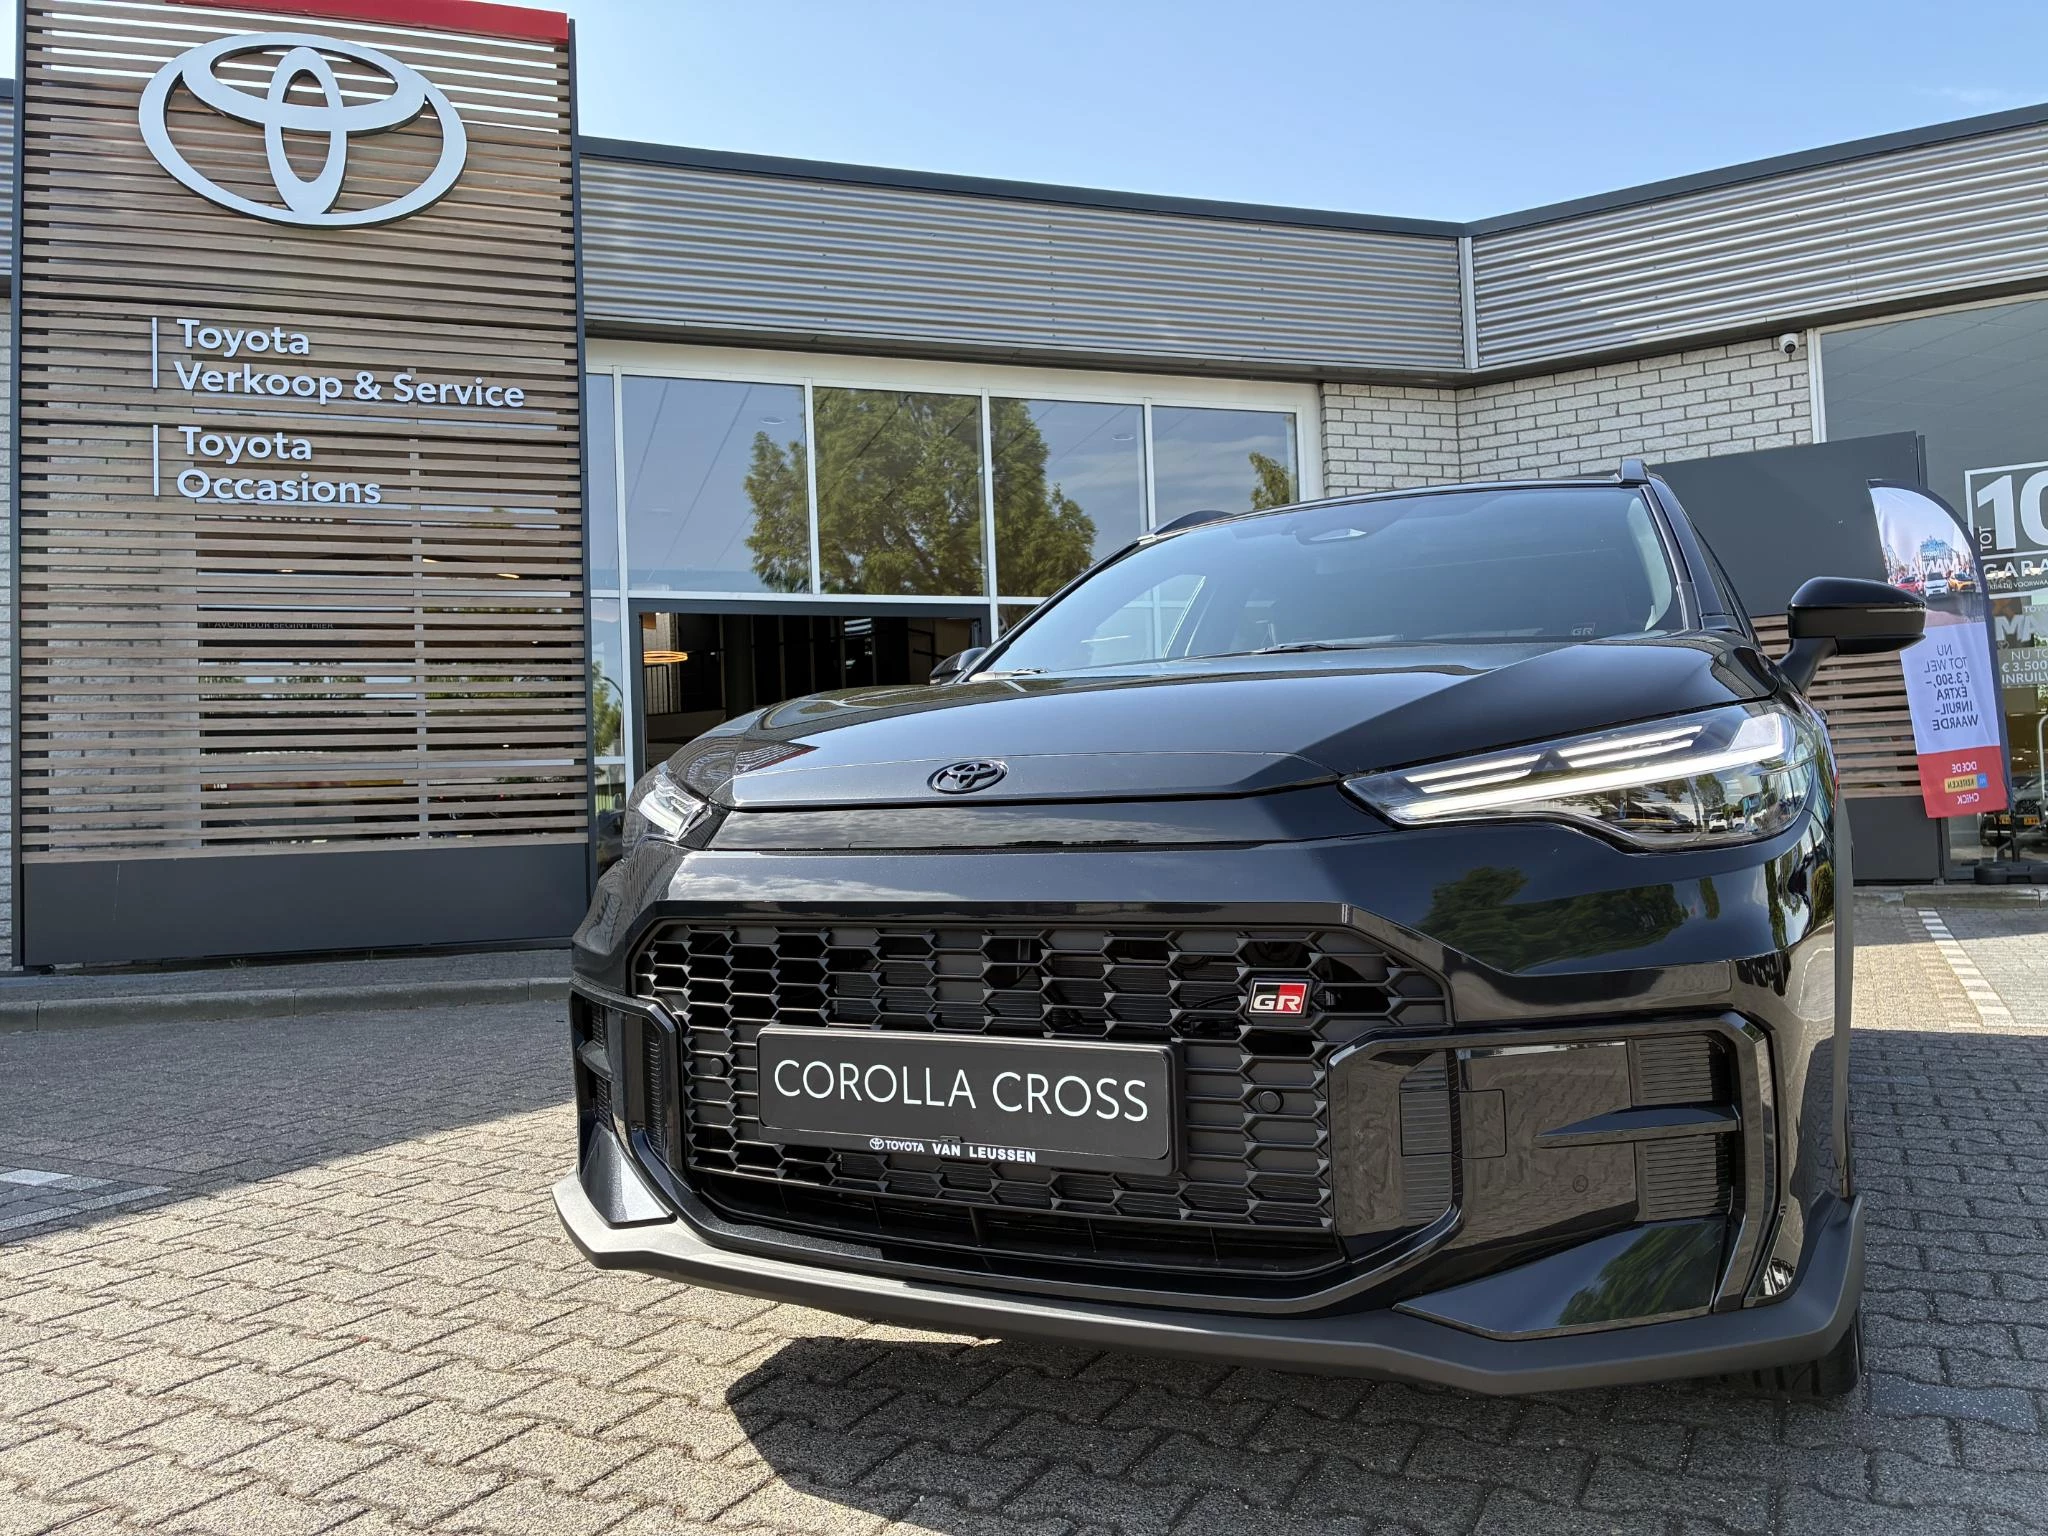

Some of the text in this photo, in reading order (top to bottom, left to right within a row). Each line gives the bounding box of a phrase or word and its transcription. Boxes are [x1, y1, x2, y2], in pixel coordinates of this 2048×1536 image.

[176, 318, 310, 357] Toyota
[174, 361, 525, 407] Verkoop & Service
[177, 426, 312, 463] Toyota
[176, 469, 381, 504] Occasions
[1979, 526, 1993, 552] TOT
[1572, 627, 1593, 636] GR
[2011, 650, 2031, 661] NU
[1253, 994, 1301, 1011] GR
[774, 1059, 1149, 1122] COROLLA CROSS
[885, 1140, 1036, 1163] TOYOTA VAN LEUSSEN
